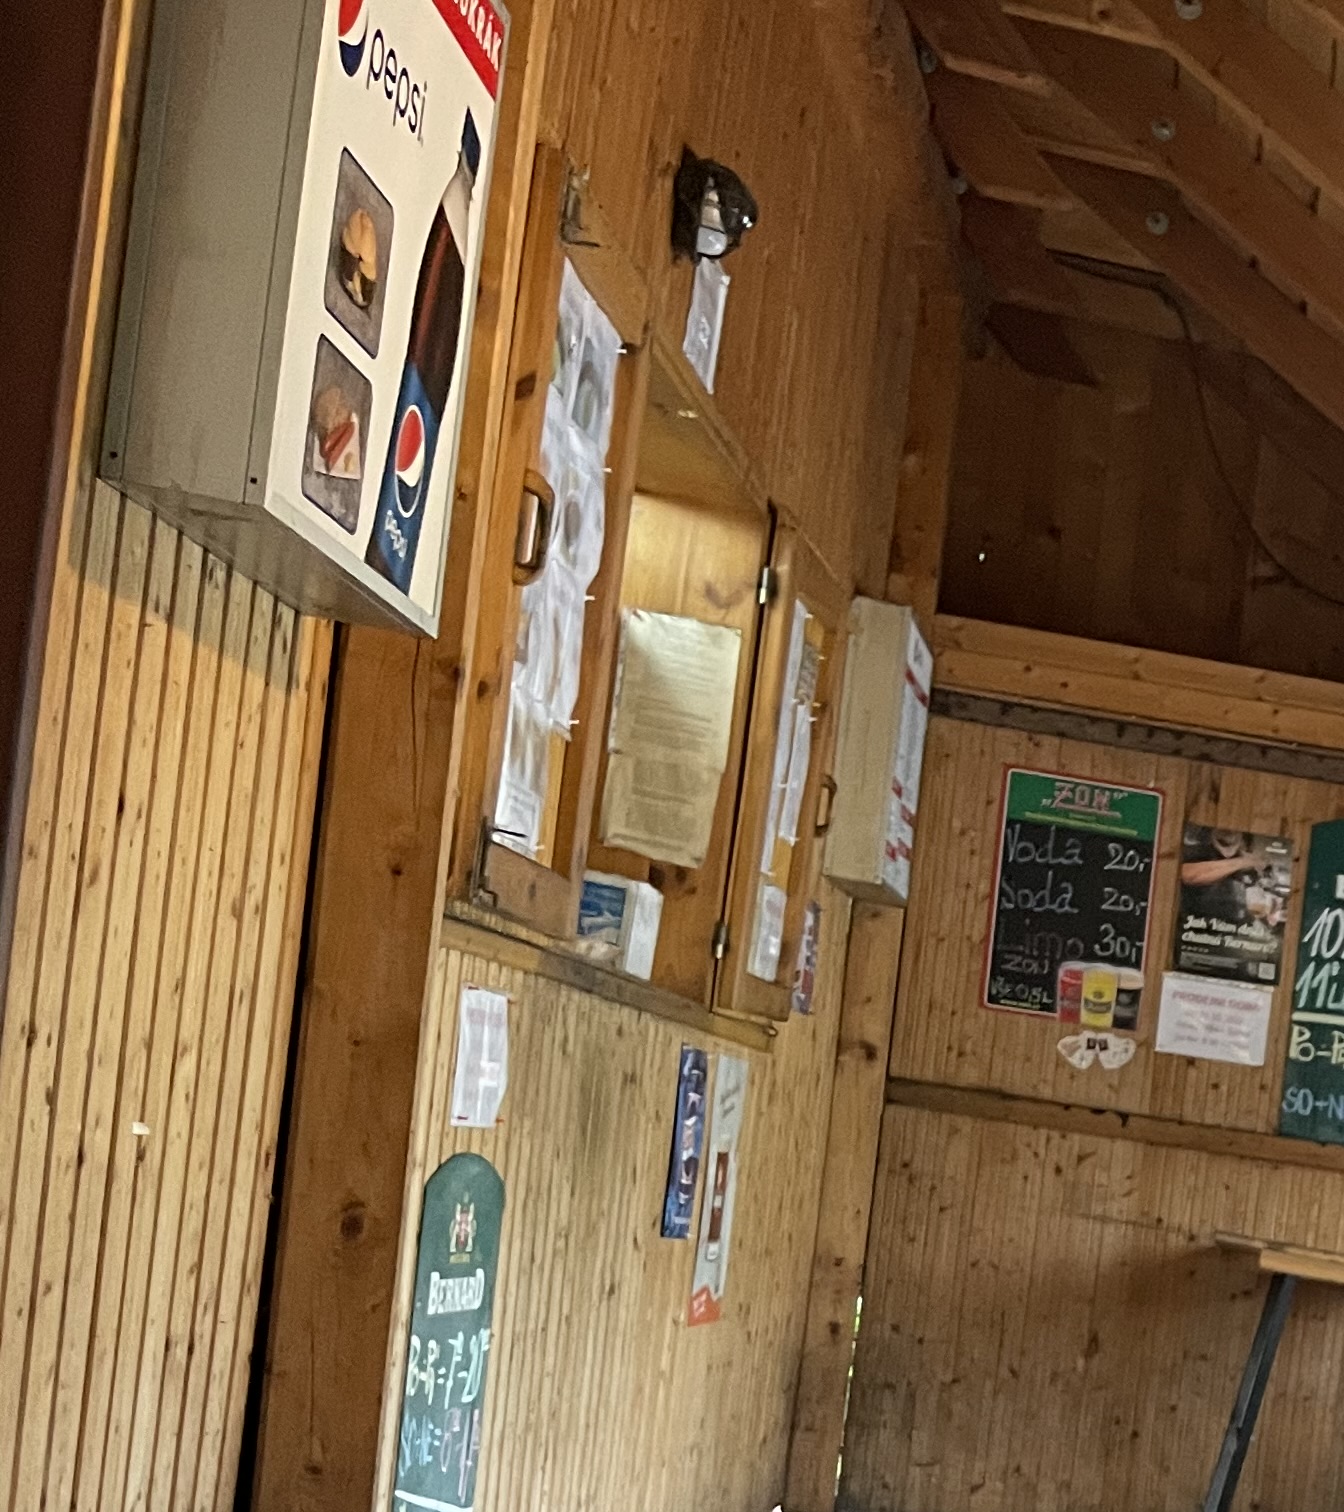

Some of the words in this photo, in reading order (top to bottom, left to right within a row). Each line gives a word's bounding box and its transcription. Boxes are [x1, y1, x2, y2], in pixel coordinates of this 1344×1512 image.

[453, 0, 501, 72] KRÁK
[366, 29, 427, 141] pepsi
[1007, 824, 1082, 864] Voda
[999, 870, 1078, 913] Soda
[427, 1268, 485, 1315] BERNARD
